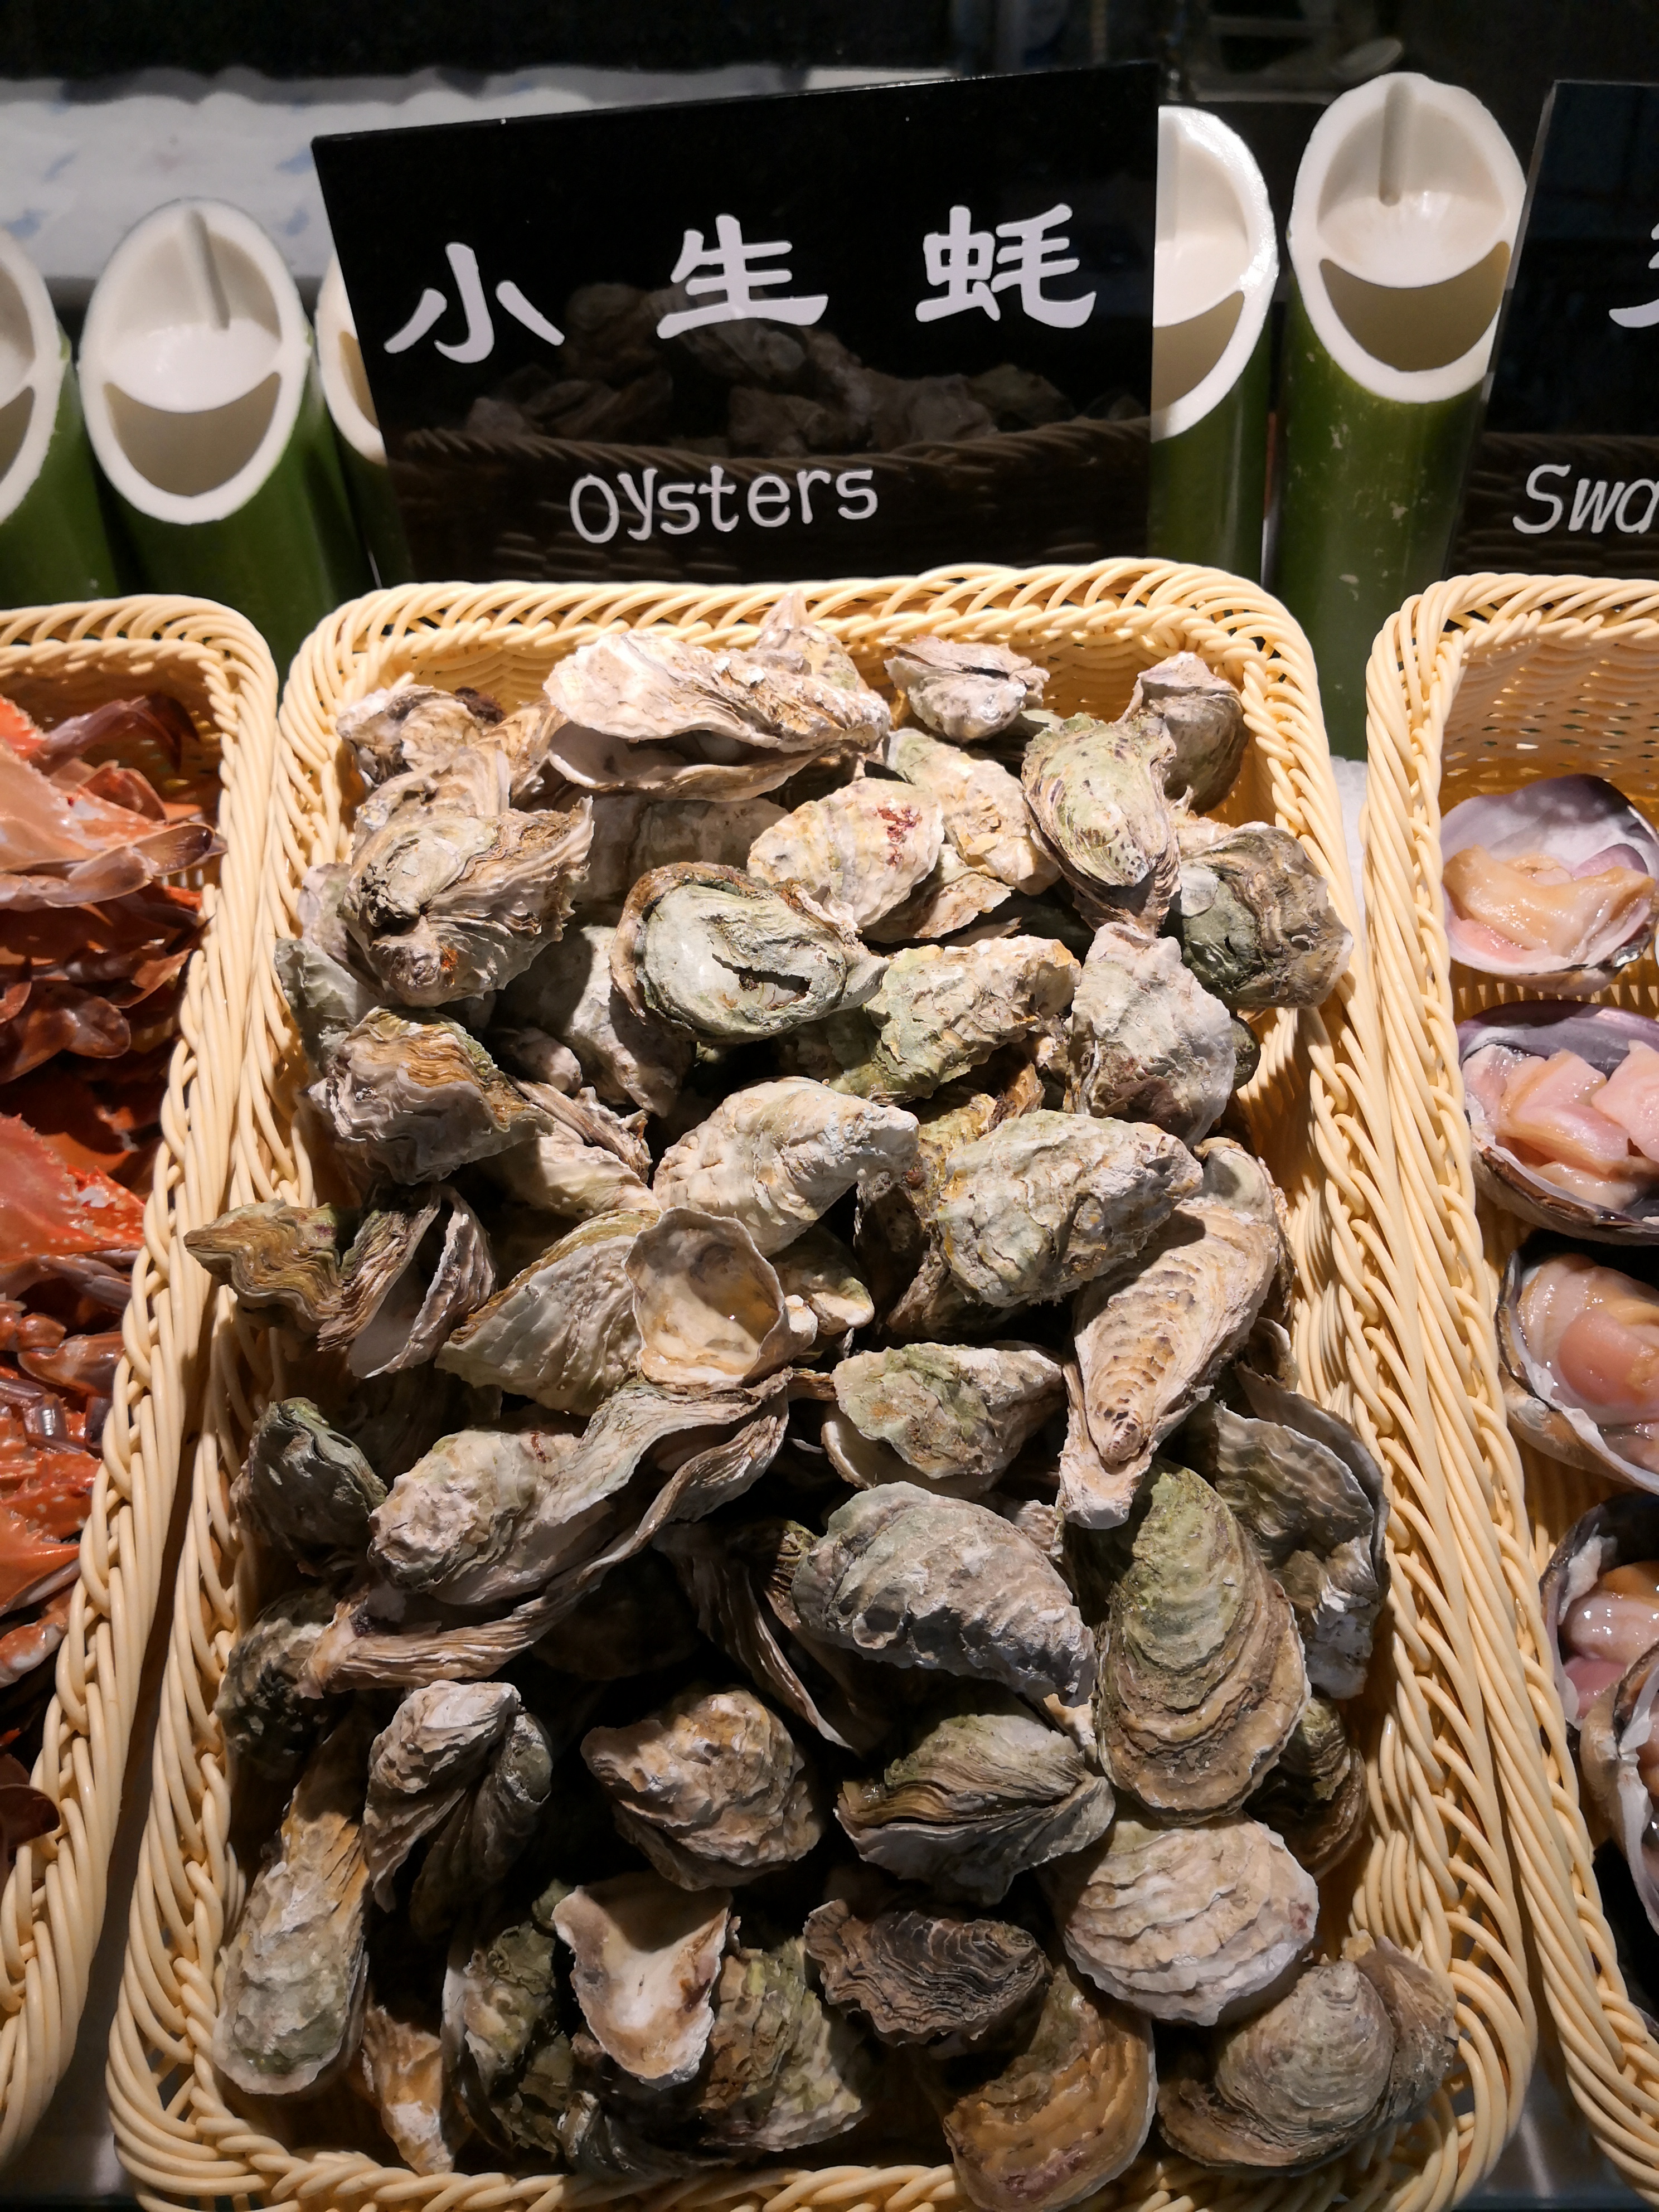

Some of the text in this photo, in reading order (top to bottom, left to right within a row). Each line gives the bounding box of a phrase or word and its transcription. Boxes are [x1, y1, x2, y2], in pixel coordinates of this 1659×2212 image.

[385, 203, 1097, 363] 小生蚝
[570, 465, 878, 544] Oysters
